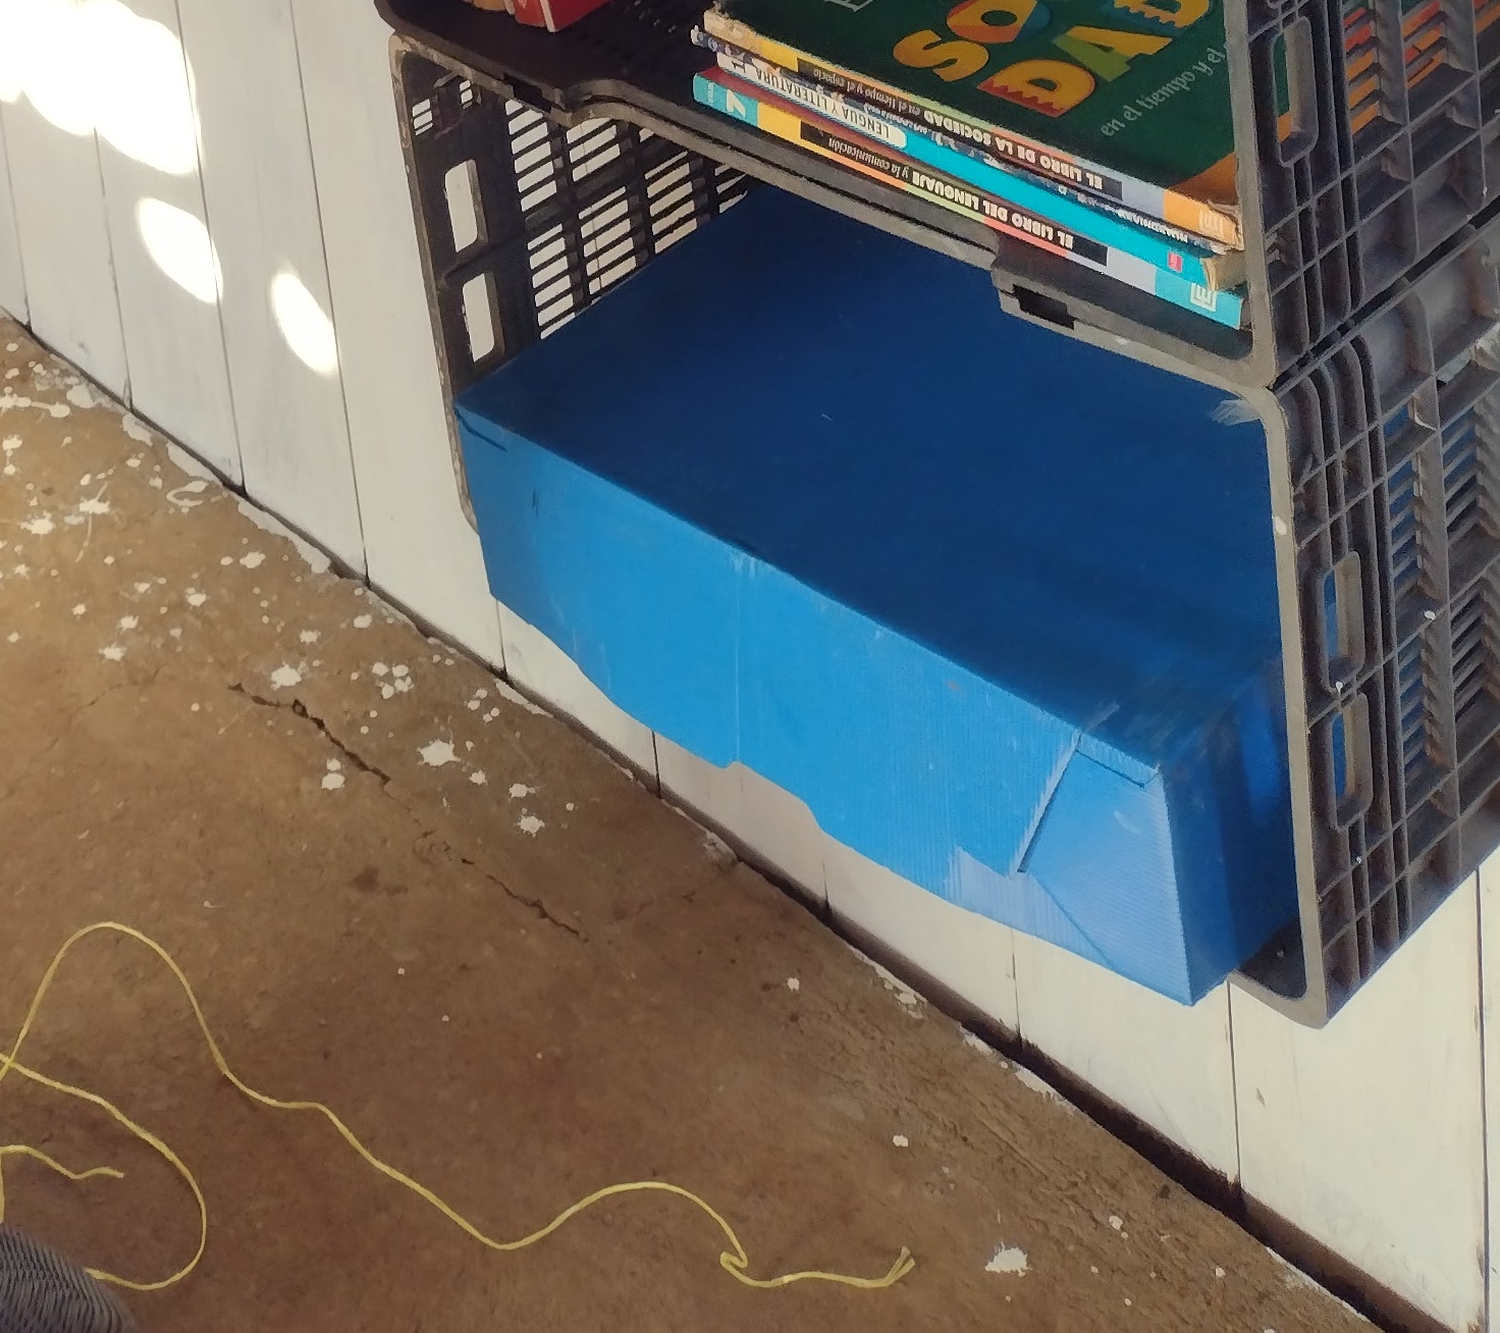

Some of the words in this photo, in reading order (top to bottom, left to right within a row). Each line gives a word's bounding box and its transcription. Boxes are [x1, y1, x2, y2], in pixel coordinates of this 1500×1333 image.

[755, 69, 828, 111] LITERATURA
[1100, 118, 1126, 137] en
[1122, 104, 1142, 121] el
[1135, 71, 1196, 110] tiempo
[1192, 60, 1214, 77] y
[1206, 47, 1226, 64] el
[830, 100, 839, 116] Y
[842, 106, 891, 139] LENGUA
[924, 110, 992, 146] SOCIEDAD
[828, 137, 892, 172] comunicación
[995, 136, 1013, 155] LA
[1017, 144, 1036, 163] DE
[891, 163, 901, 178] la
[1040, 155, 1082, 183] LIBRO
[1085, 172, 1103, 190] EL
[912, 171, 979, 211] LENGUAJE
[983, 201, 1008, 222] DEL
[1011, 213, 1053, 241] LIBRO
[1057, 232, 1074, 250] EL
